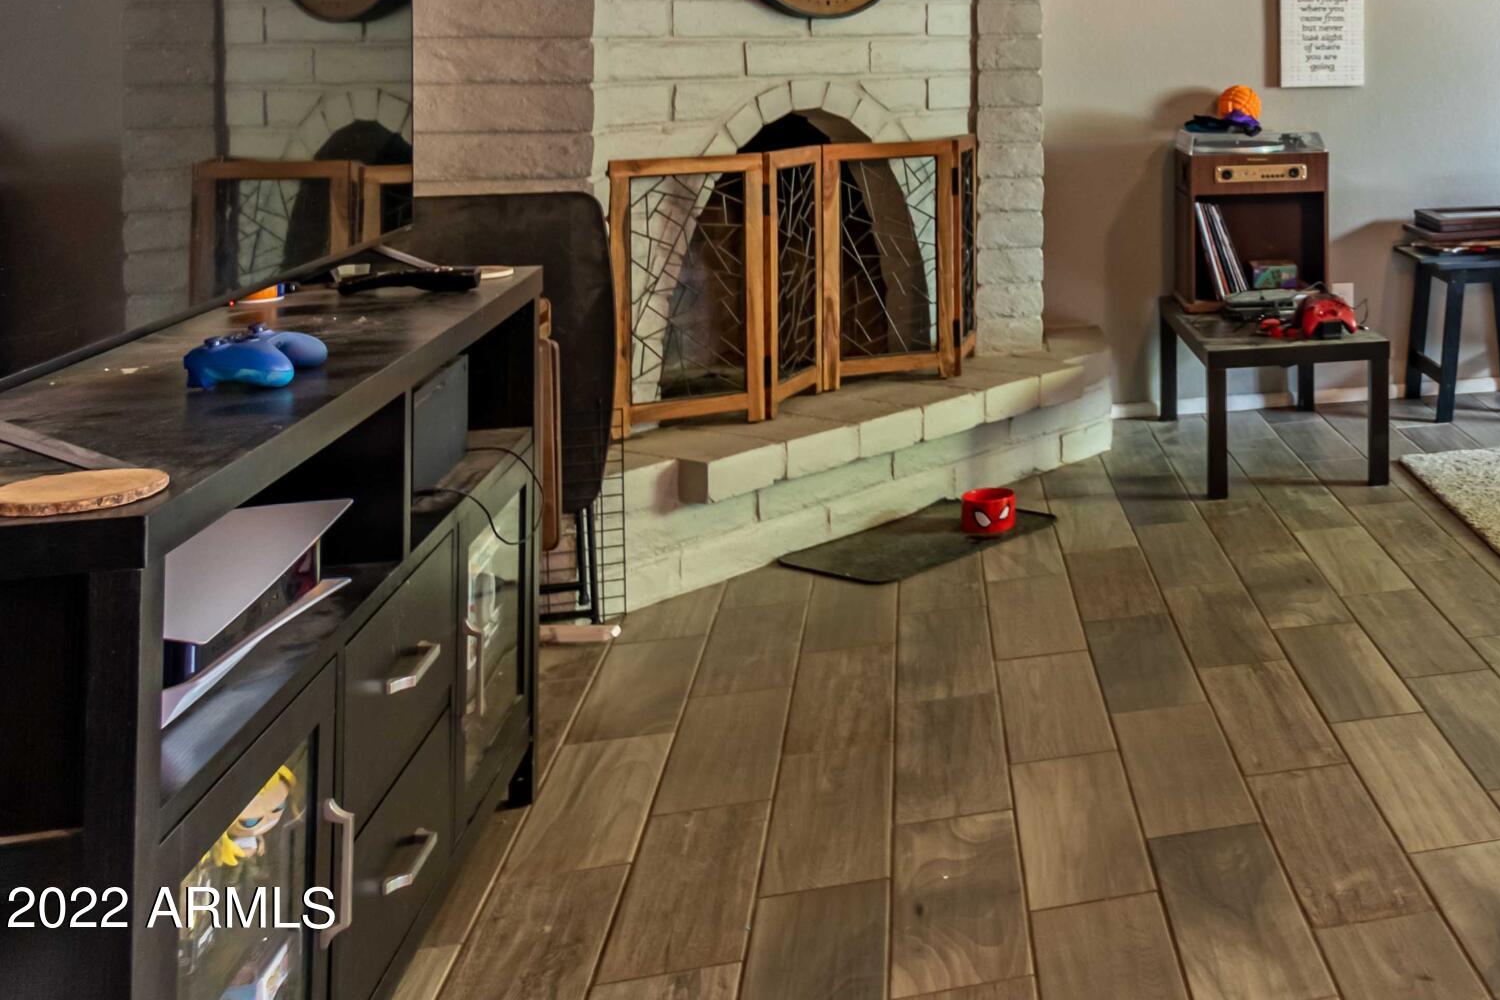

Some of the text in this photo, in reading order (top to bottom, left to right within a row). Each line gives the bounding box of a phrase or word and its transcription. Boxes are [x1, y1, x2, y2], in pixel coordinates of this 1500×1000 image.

[1300, 4, 1345, 16] where you
[1323, 13, 1345, 24] from
[1302, 24, 1316, 32] but
[1321, 34, 1343, 43] sight
[1304, 43, 1341, 53] of where
[1305, 55, 1321, 63] you
[1310, 63, 1335, 72] going
